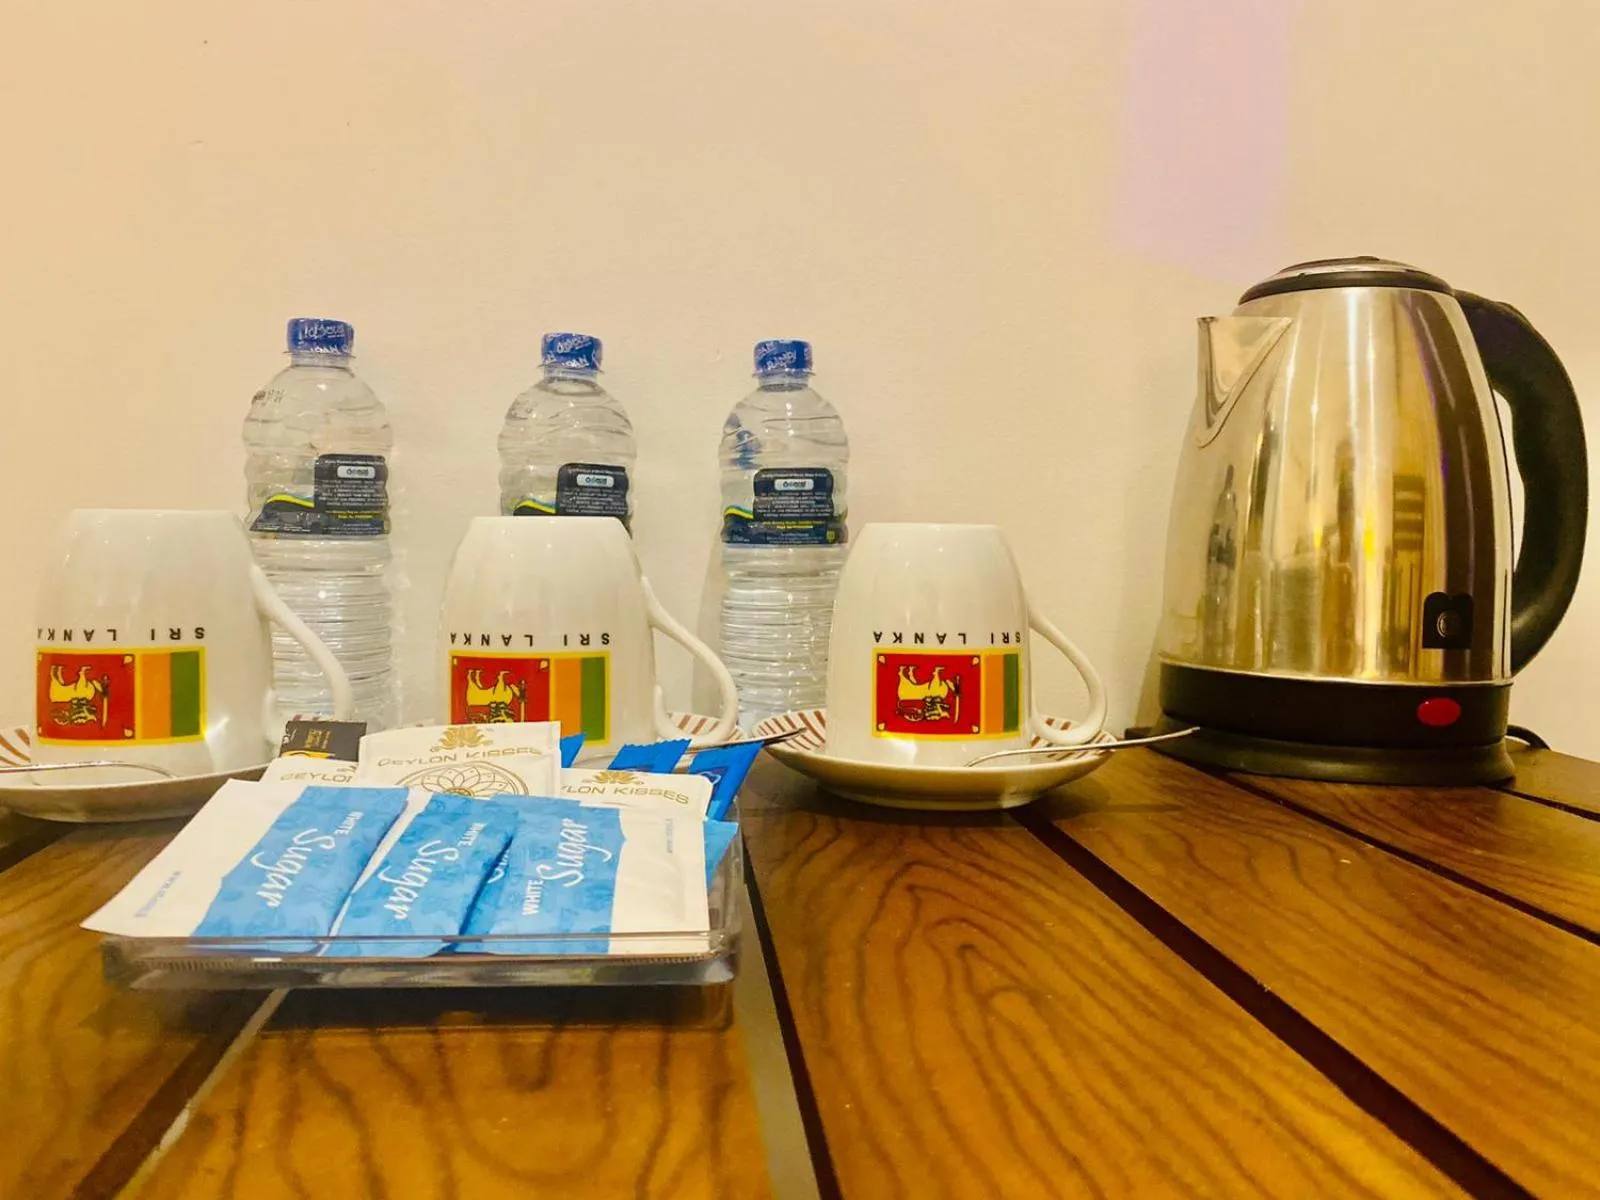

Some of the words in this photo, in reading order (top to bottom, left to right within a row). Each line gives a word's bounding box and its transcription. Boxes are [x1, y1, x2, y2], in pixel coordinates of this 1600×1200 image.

[149, 627, 205, 641] SRI
[450, 633, 533, 646] LANKA
[563, 633, 610, 646] SRI
[873, 631, 967, 645] LANKA
[990, 632, 1021, 644] SRI
[377, 752, 457, 767] CEYLON
[613, 786, 689, 805] KISSES
[249, 828, 336, 908] Sugar
[521, 879, 544, 916] WHITE
[537, 818, 612, 888] Sugar
[377, 840, 460, 920] Sugar
